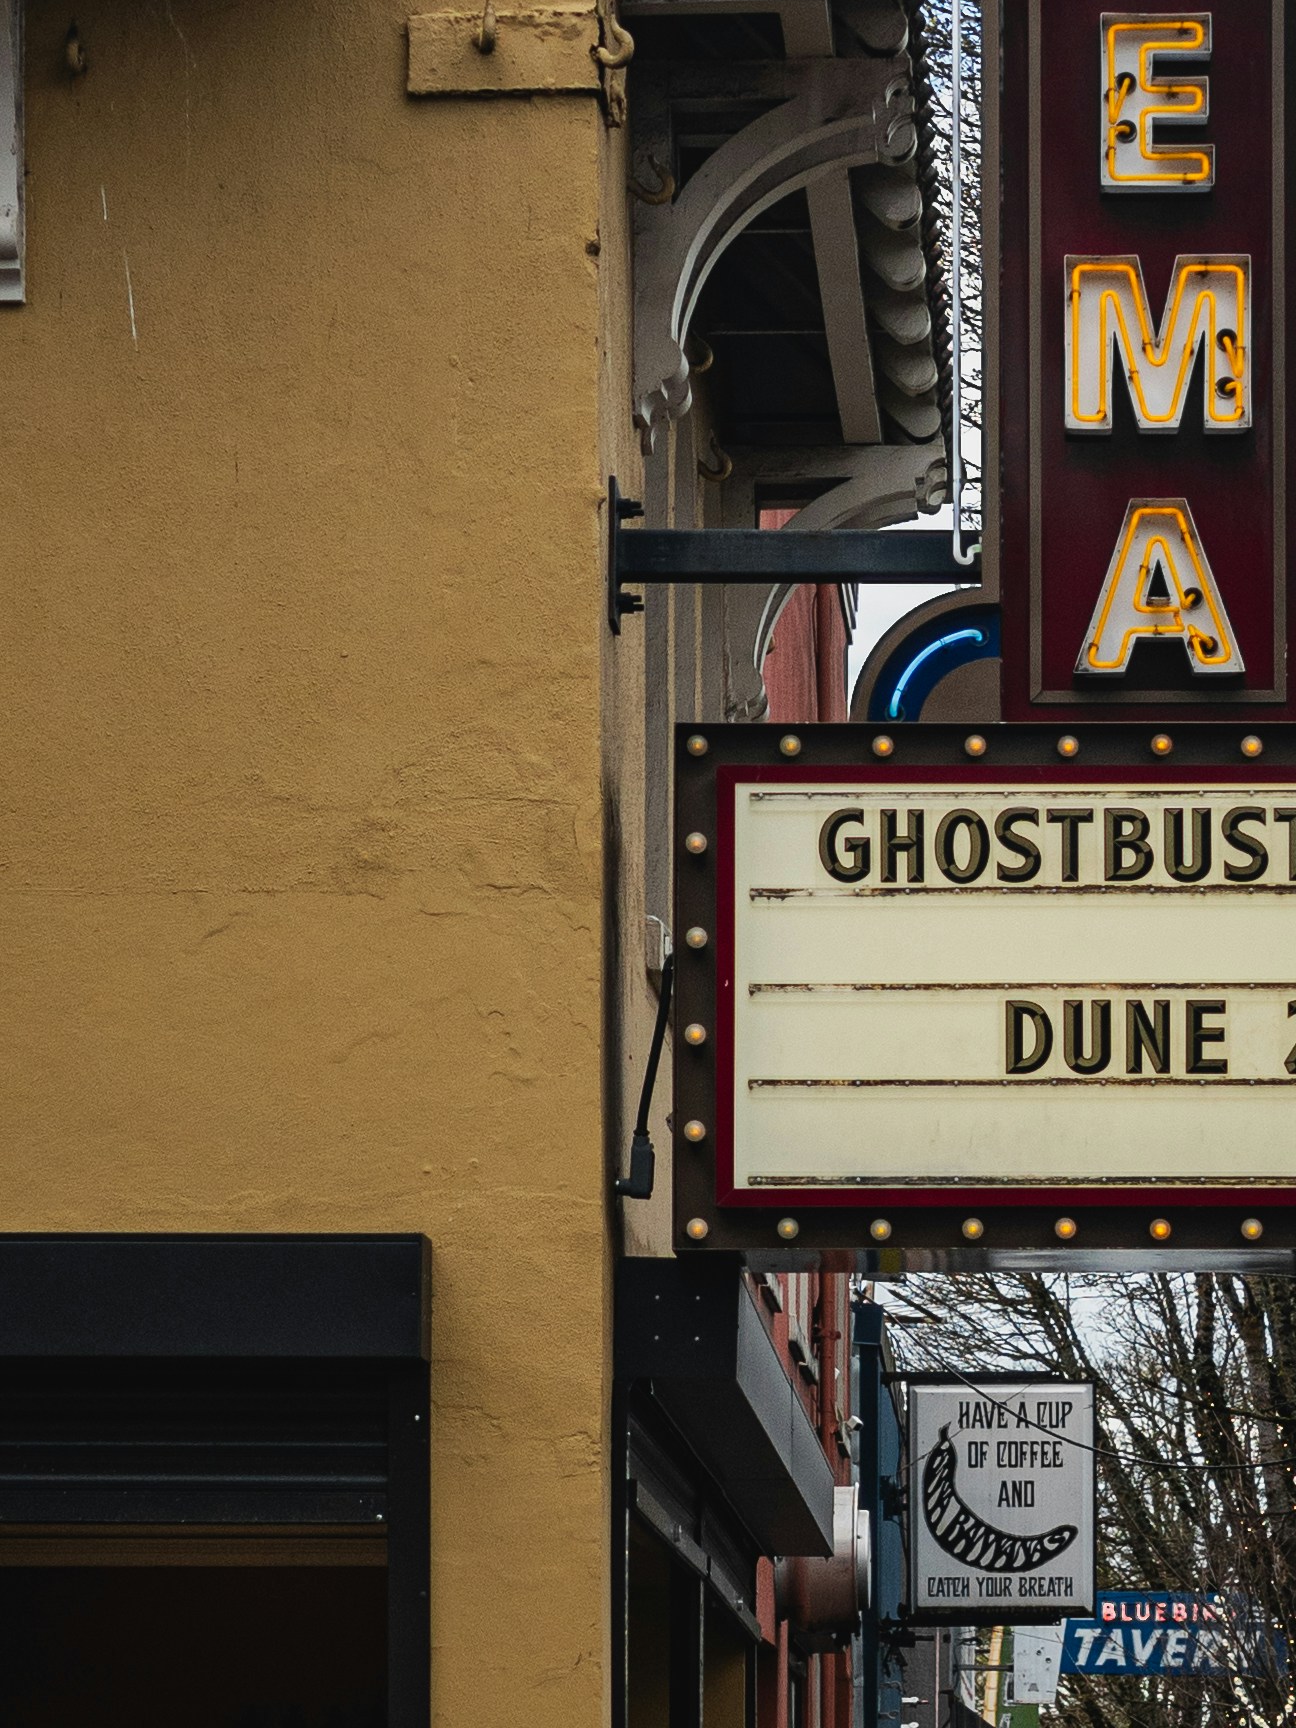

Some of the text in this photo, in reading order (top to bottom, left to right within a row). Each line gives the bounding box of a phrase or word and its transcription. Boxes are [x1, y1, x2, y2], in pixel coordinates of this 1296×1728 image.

[1004, 998, 1229, 1076] DUNE
[958, 1401, 1073, 1429] HAVE A CUP
[967, 1440, 1064, 1469] OF COFFEE
[997, 1480, 1035, 1508] AND
[927, 1576, 1074, 1598] CATCH YOUR BREATH
